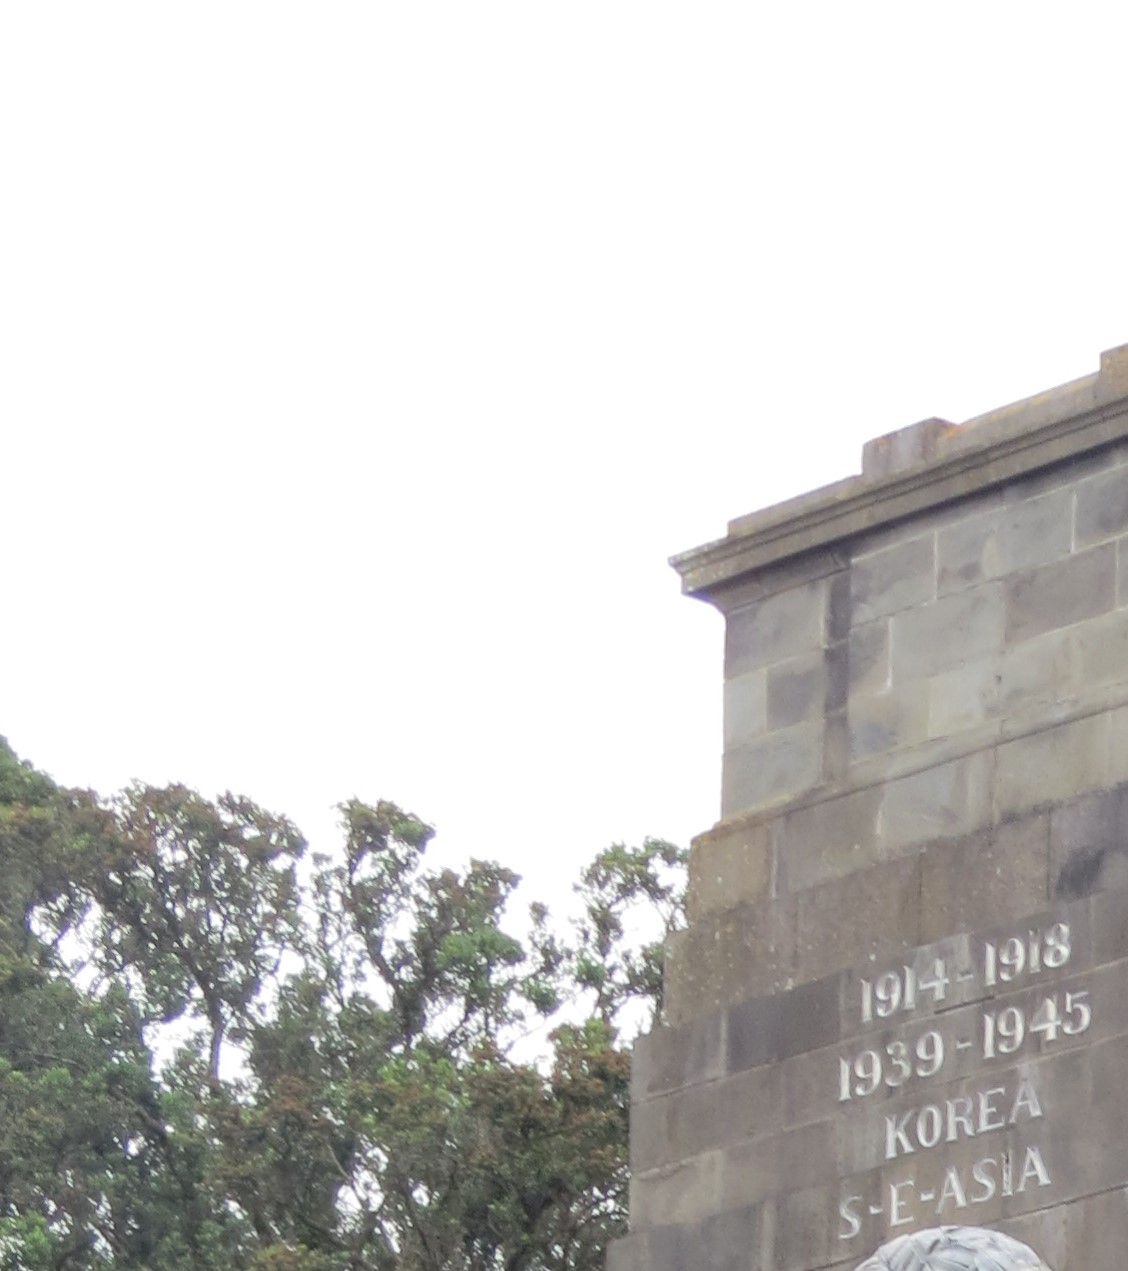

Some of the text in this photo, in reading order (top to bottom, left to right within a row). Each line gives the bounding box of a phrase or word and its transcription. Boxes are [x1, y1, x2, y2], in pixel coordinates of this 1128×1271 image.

[861, 923, 1071, 1022] 1914-1918
[839, 991, 1092, 1101] 1939-1945
[885, 1079, 1043, 1159] KOREA
[839, 1146, 1051, 1240] S-E-ASIA
